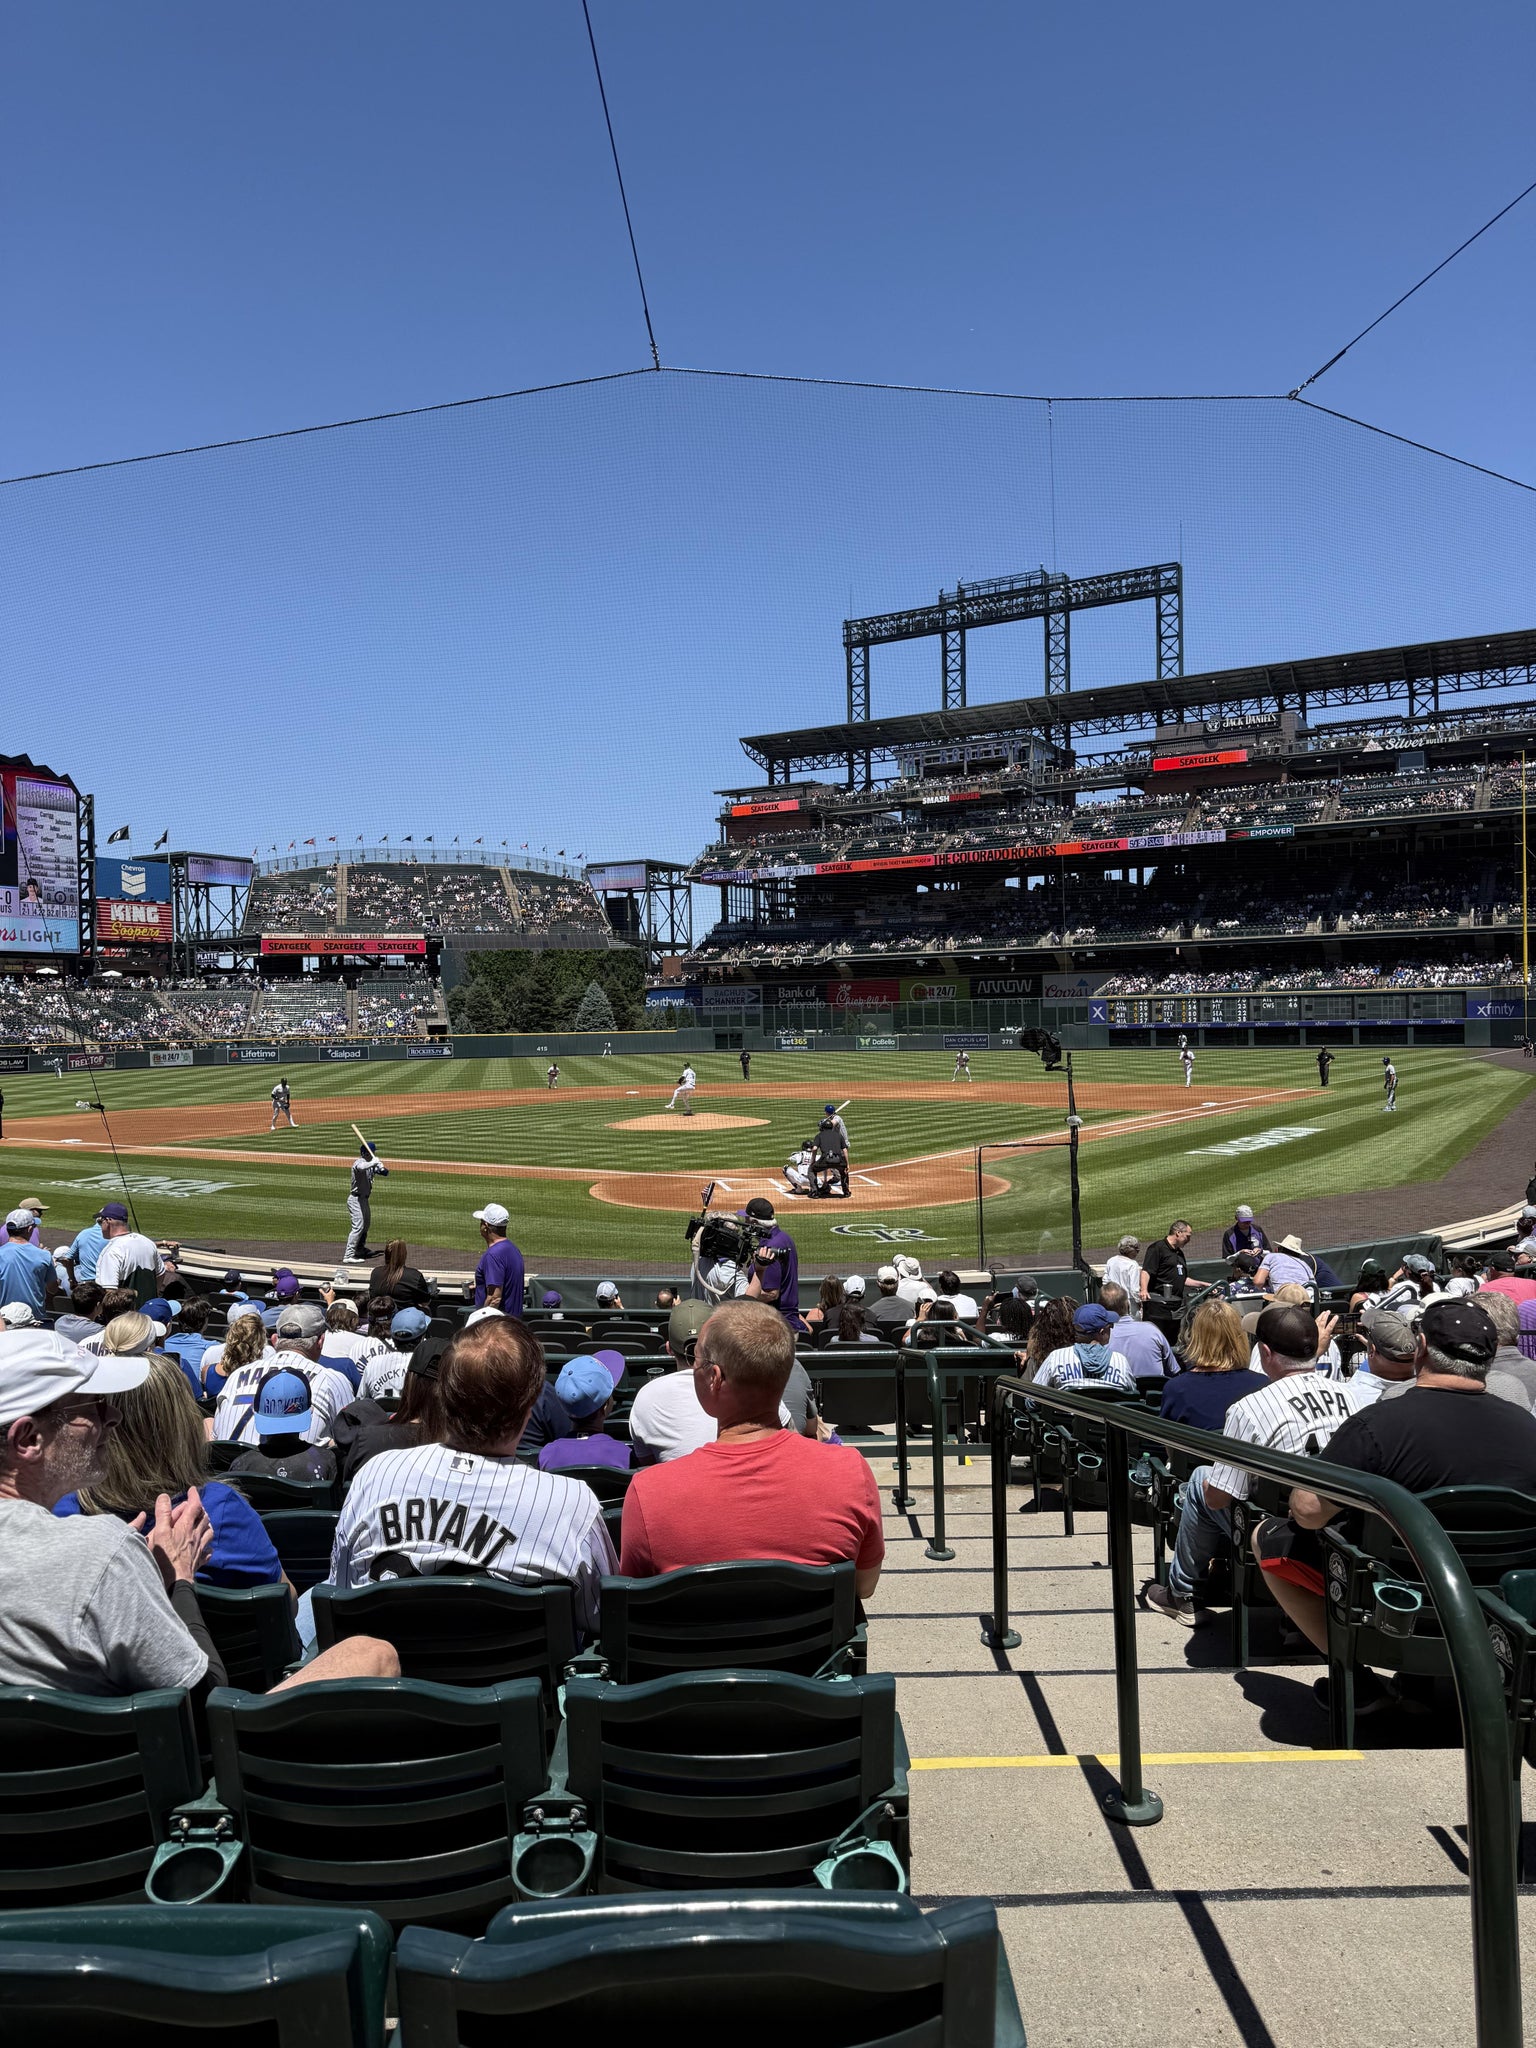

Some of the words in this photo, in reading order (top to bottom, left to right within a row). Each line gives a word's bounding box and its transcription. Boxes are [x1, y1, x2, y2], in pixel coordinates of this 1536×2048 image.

[1222, 717, 1243, 728] JACK
[1385, 737, 1425, 750] Silver
[1180, 754, 1220, 766] SEATGEEK
[751, 803, 779, 813] SEATGEEK
[1250, 827, 1292, 837] EMPOWER
[1081, 840, 1120, 852] SEATGEEK
[933, 853, 950, 866] THE
[953, 849, 1009, 864] COLORADO
[1011, 844, 1056, 859] ROCKIES
[121, 864, 146, 872] Chevron
[821, 862, 852, 873] SEATGEEK
[47, 893, 51, 901] 0
[70, 894, 74, 903] 0
[0, 904, 12, 913] UTS
[110, 904, 159, 923] KING
[111, 921, 160, 939] Soopers
[20, 929, 62, 943] LIGHT
[268, 942, 311, 951] SEATGEEK
[323, 942, 366, 951] SEATGEEK
[377, 942, 419, 951] SEATGEEK
[197, 952, 218, 960] PLATTE
[778, 985, 803, 998] Bank
[806, 985, 816, 998] of
[936, 986, 956, 997] 24/7
[977, 979, 1032, 994] ARROW
[1045, 984, 1082, 998] Coors
[714, 989, 746, 998] BACHUS
[645, 997, 694, 1007] Southwest
[704, 998, 746, 1006] SCHANKER
[779, 997, 825, 1010] Colorado
[1477, 1001, 1515, 1016] xfinity
[781, 1038, 808, 1046] bet365
[168, 1053, 180, 1061] 24/7
[240, 1050, 276, 1058] Lifetime
[330, 1048, 361, 1059] dialpad
[90, 1056, 104, 1065] TOP
[1057, 1361, 1121, 1385] SANRG
[373, 1368, 400, 1393] CHUCK
[1287, 1389, 1351, 1424] PAPA
[380, 1497, 518, 1567] BRYANT
